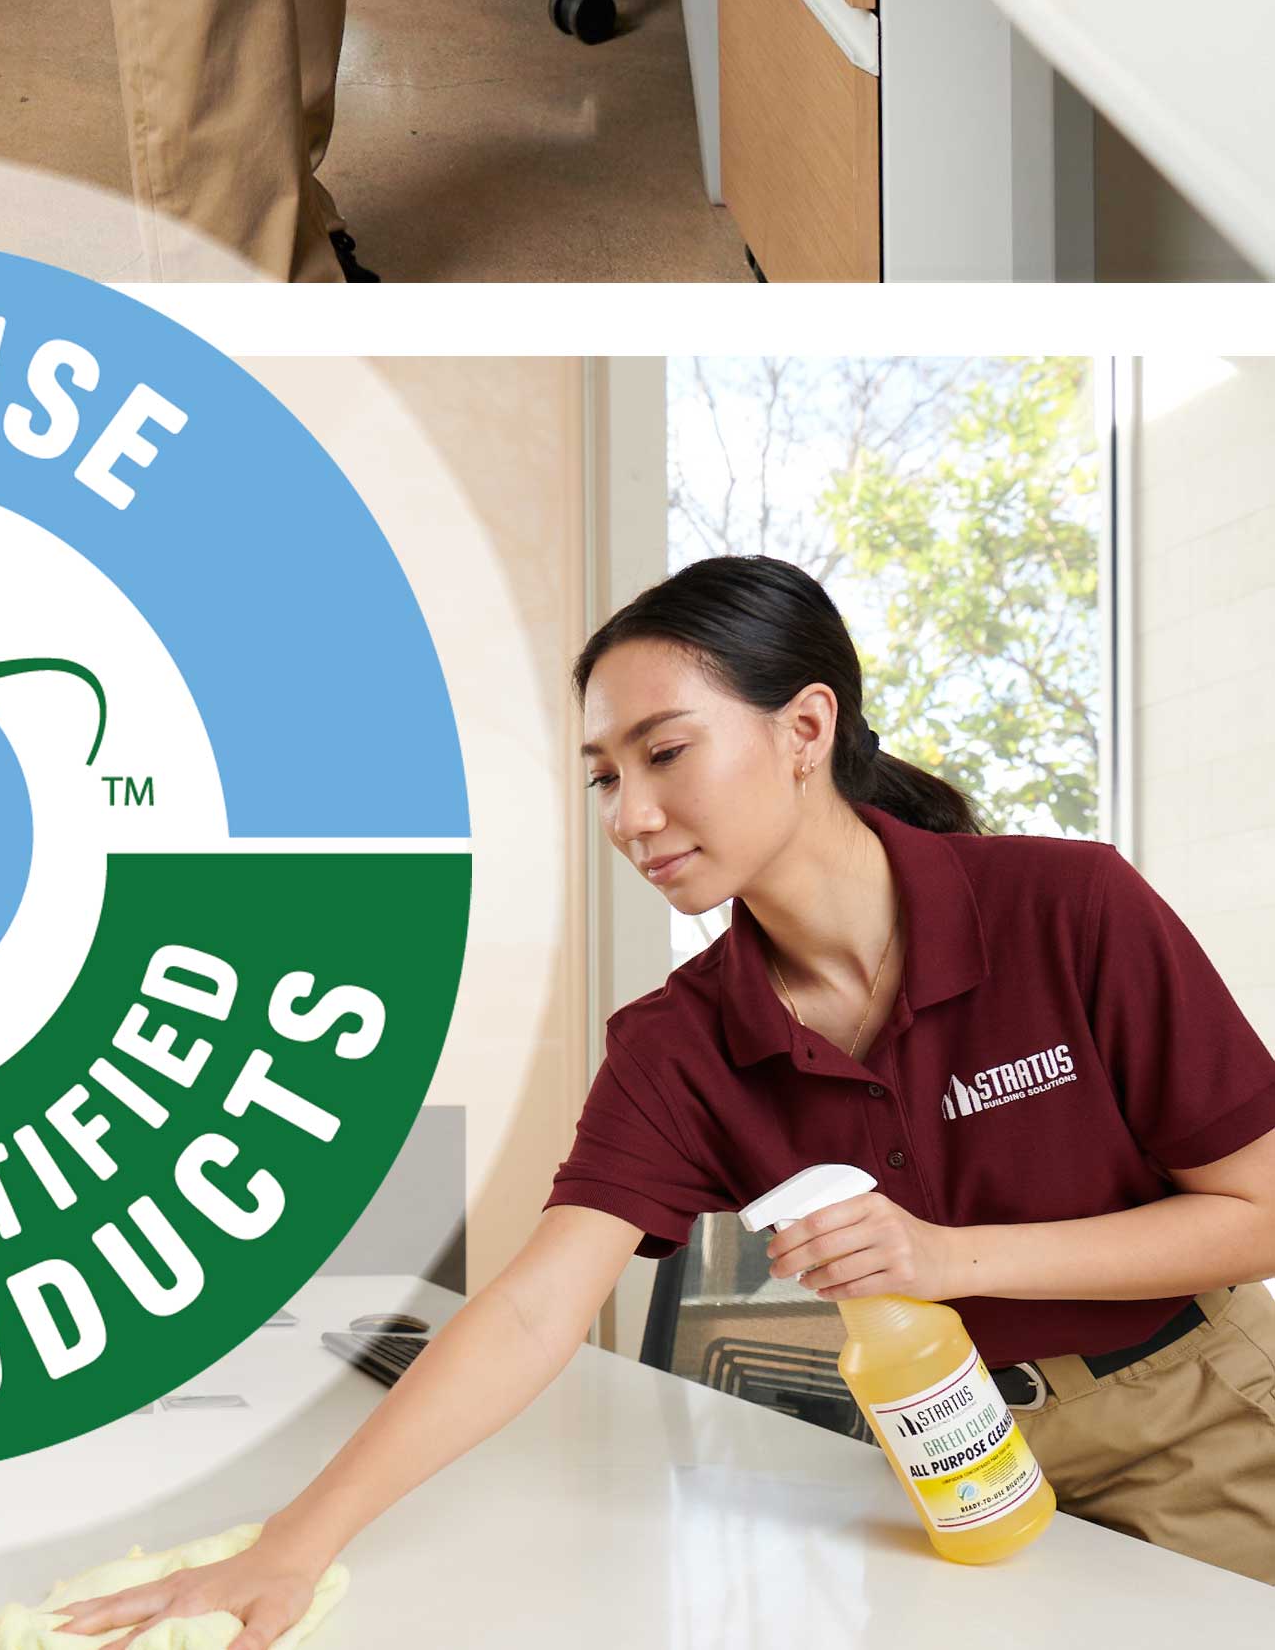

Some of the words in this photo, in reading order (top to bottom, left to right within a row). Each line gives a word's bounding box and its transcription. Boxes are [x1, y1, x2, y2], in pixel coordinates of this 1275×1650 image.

[974, 1044, 1074, 1100] STRATUS
[982, 1091, 1026, 1110] BUILDING
[1027, 1073, 1078, 1096] SOLUTIONS
[917, 1385, 974, 1427] STRATUS
[923, 1428, 967, 1457] GREEN
[965, 1403, 998, 1438] CLEAN
[909, 1464, 930, 1477] ALL
[931, 1439, 987, 1474] PURPOSE
[987, 1408, 1013, 1446] CLEANE
